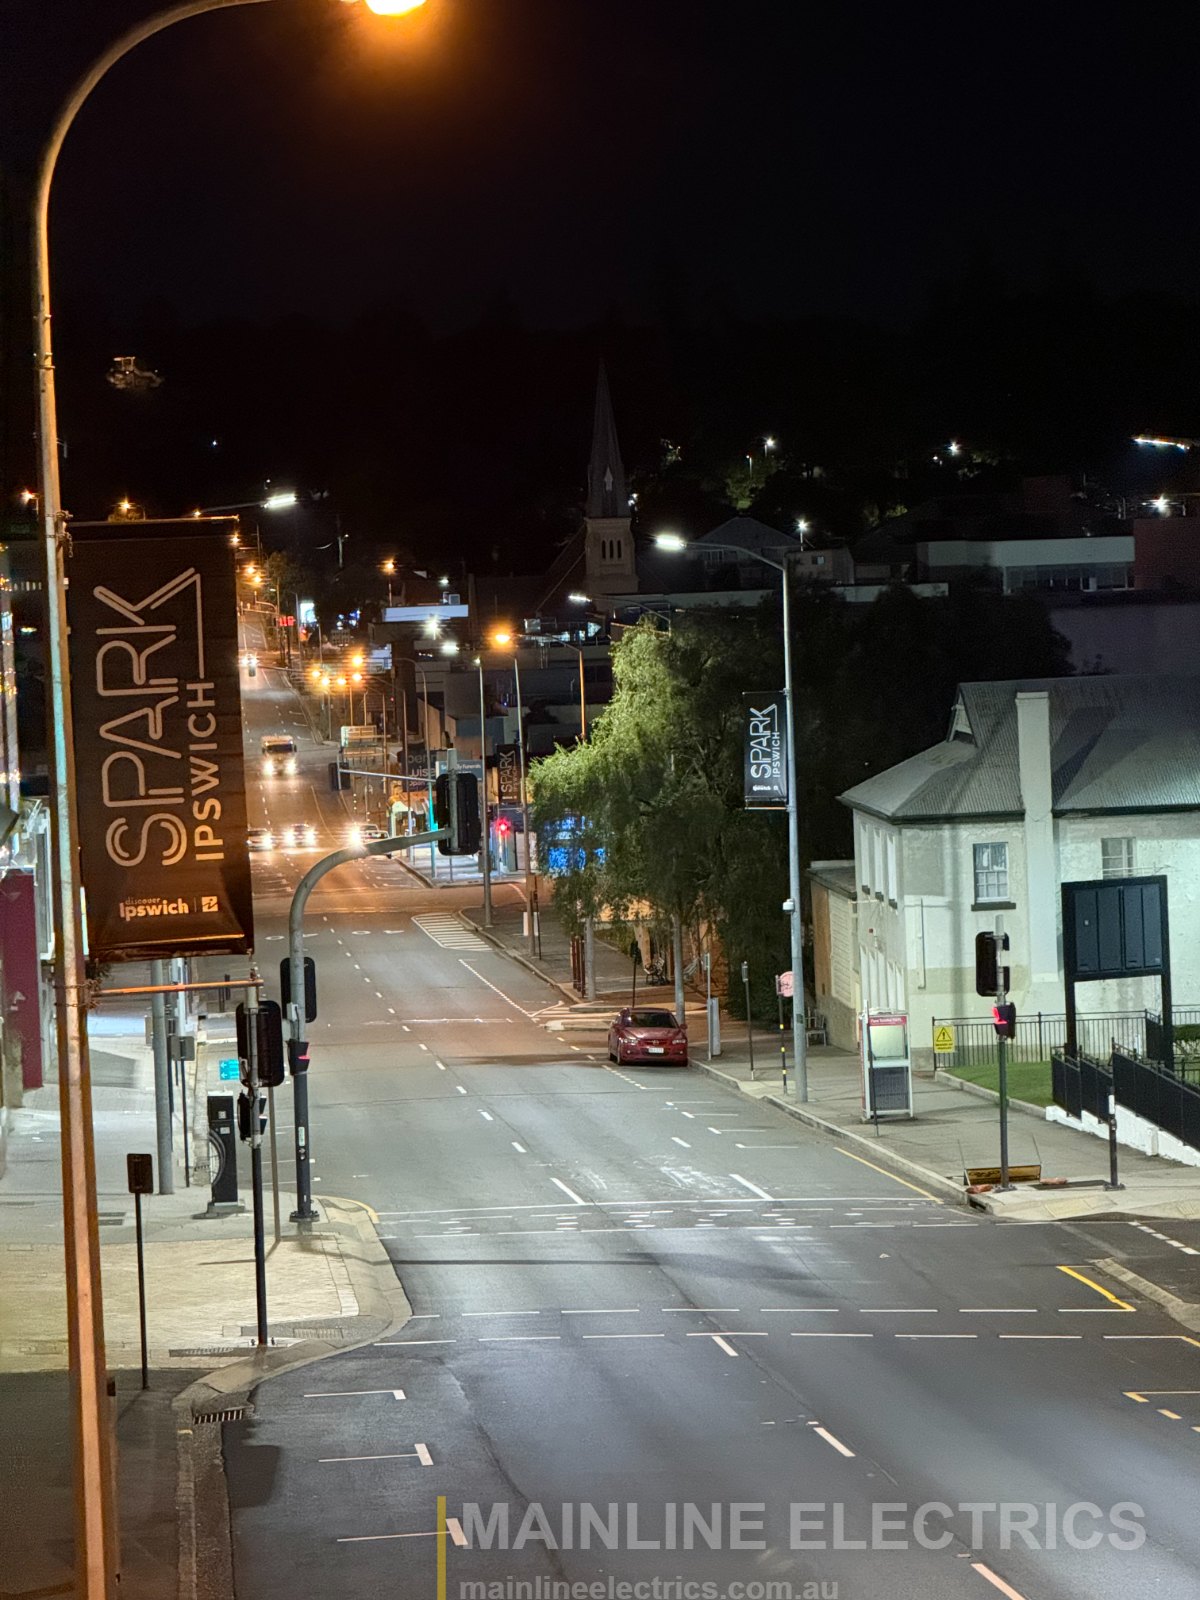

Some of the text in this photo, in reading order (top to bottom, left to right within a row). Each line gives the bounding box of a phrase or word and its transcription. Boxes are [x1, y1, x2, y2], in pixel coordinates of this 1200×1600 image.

[93, 567, 201, 867] SPARK
[749, 703, 778, 779] SPARK
[771, 731, 780, 778] IPSWICH
[186, 681, 224, 861] IPSWICH
[499, 750, 516, 793] SPARK
[119, 898, 189, 922] Ipswich
[124, 896, 161, 905] discover
